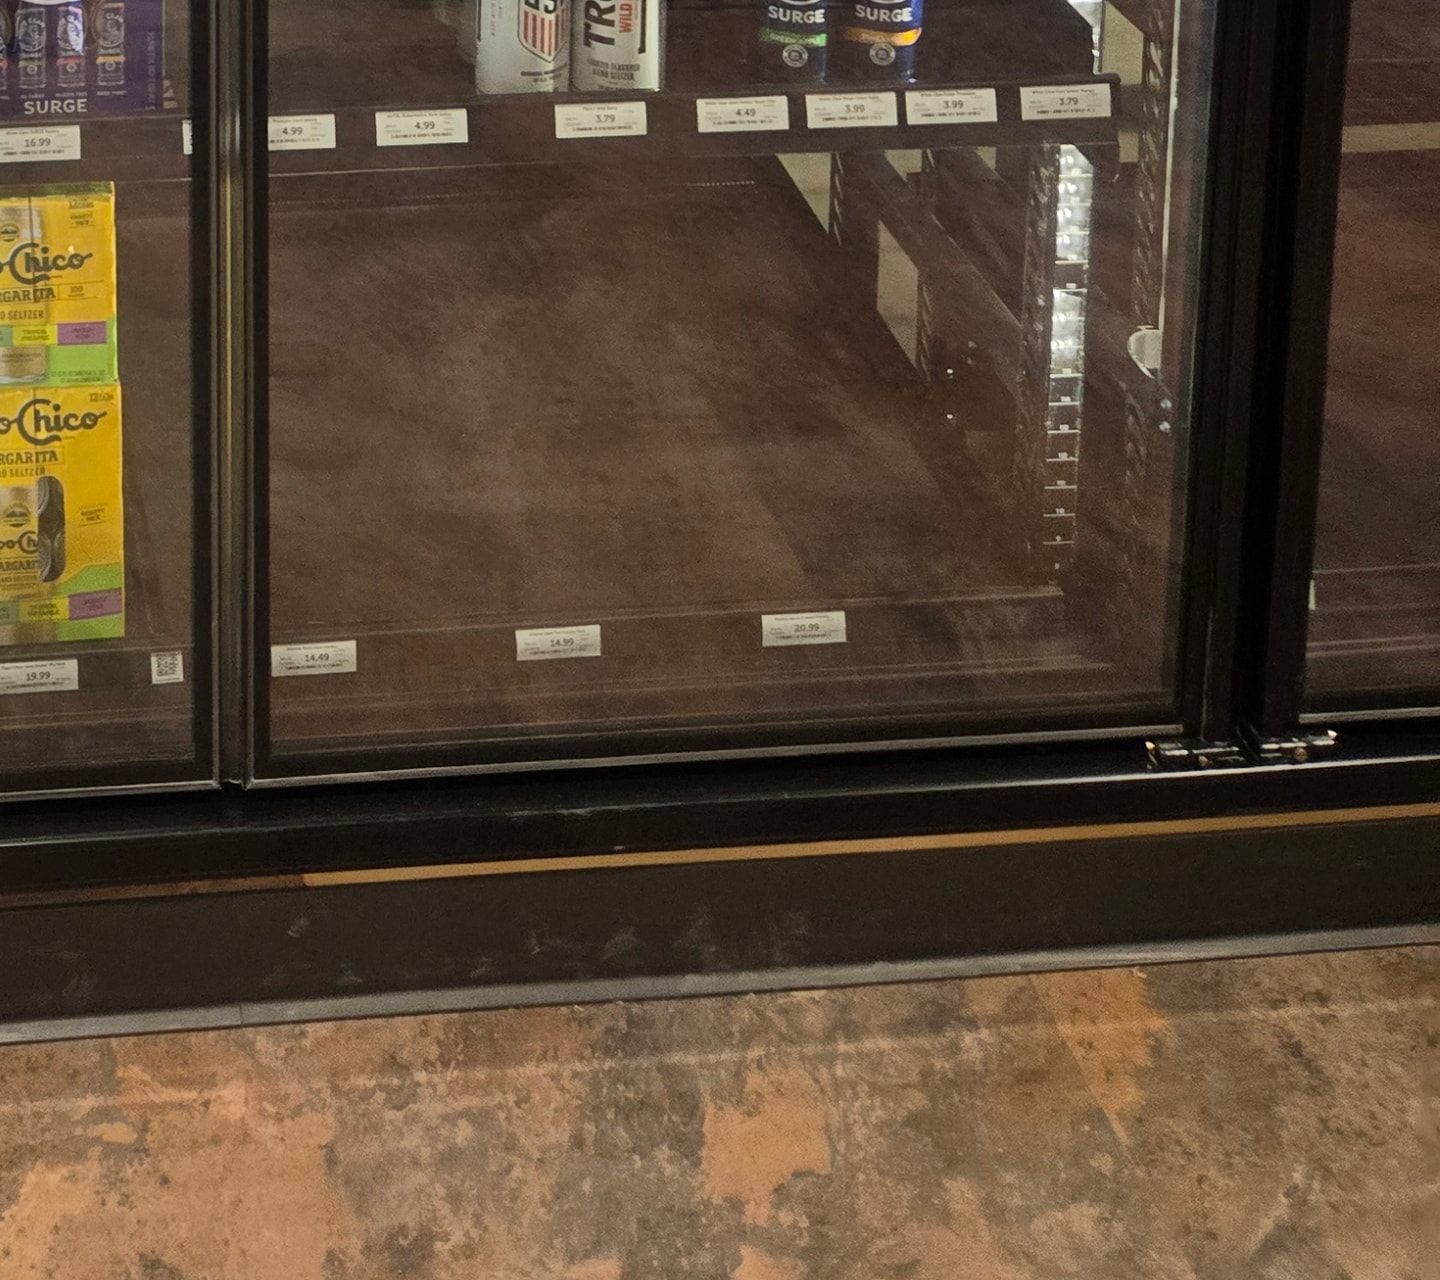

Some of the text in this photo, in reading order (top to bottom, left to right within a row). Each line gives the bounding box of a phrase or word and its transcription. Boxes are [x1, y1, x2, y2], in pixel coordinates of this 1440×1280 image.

[618, 2, 633, 33] WILD
[768, 6, 825, 25] SURGE
[23, 98, 88, 115] SURGE
[1059, 96, 1079, 107] 3.79
[281, 126, 304, 136] 4.99
[24, 137, 52, 148] 16.99
[791, 622, 823, 636] 20.99
[25, 671, 51, 682] 19.99
